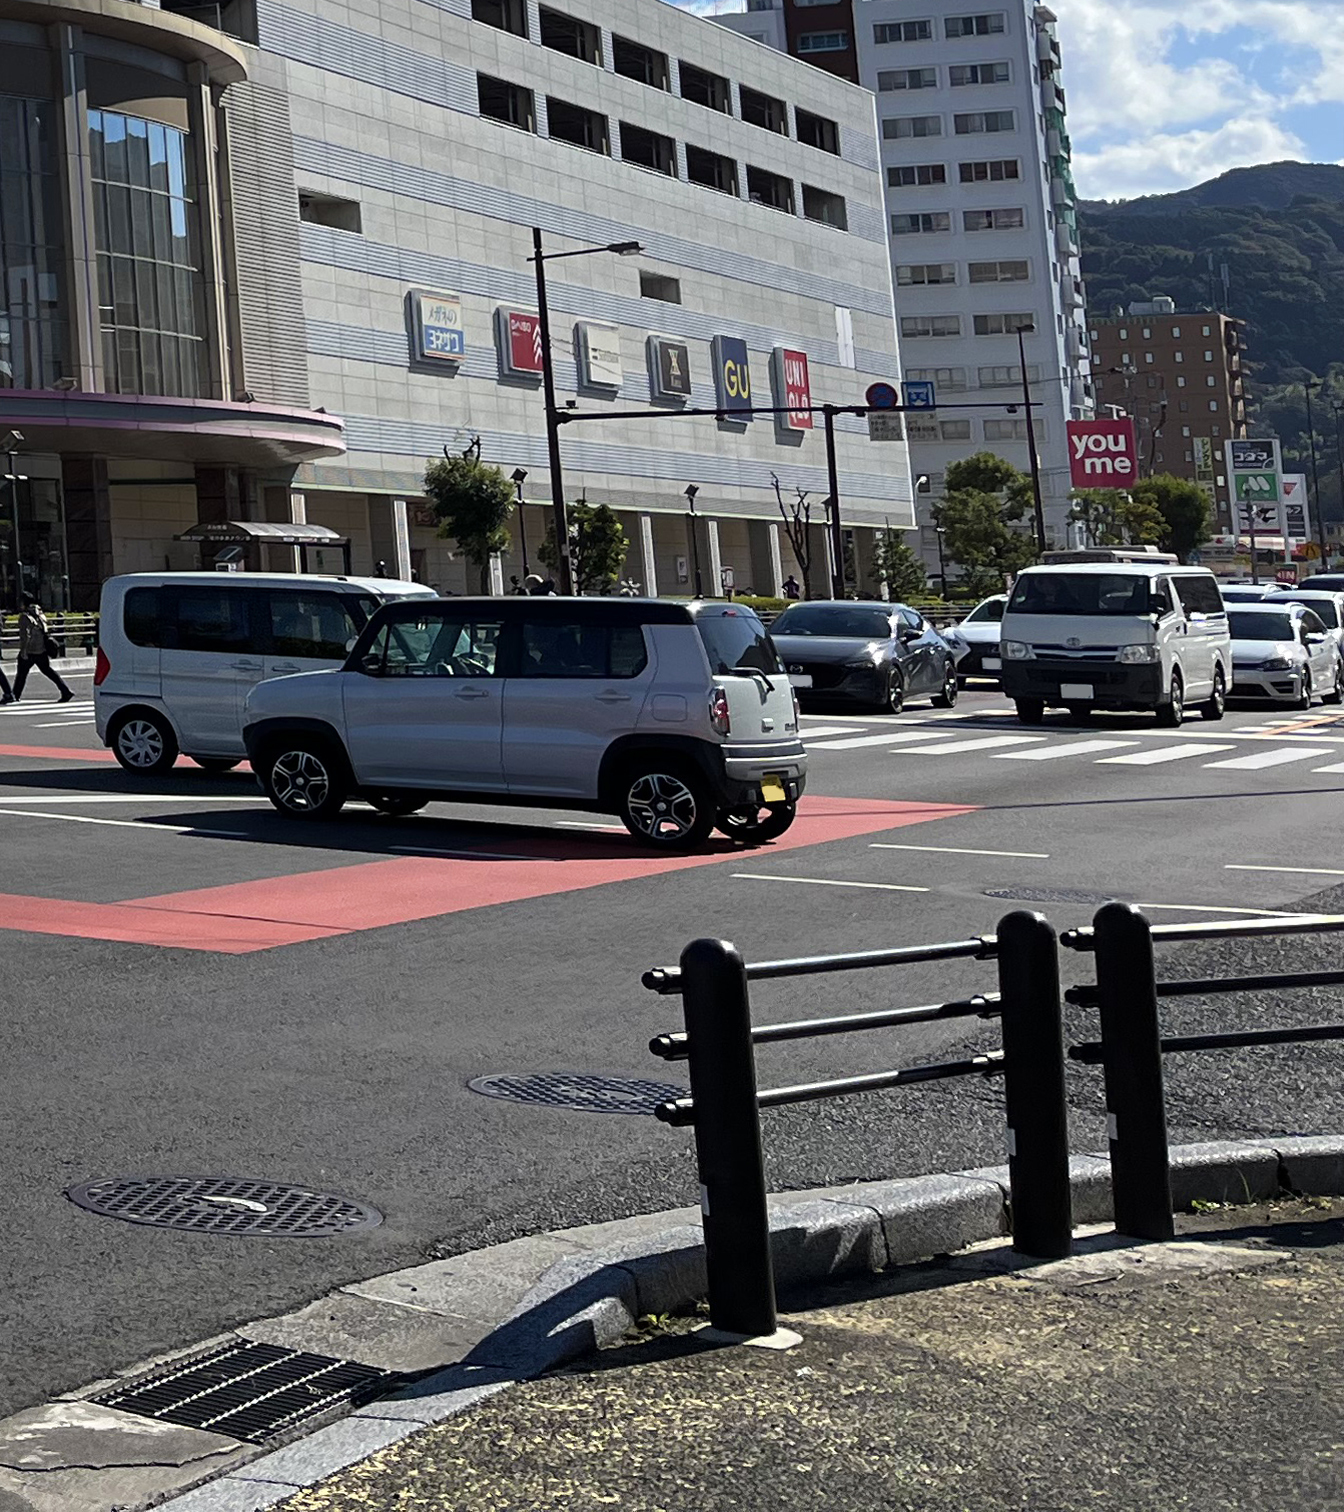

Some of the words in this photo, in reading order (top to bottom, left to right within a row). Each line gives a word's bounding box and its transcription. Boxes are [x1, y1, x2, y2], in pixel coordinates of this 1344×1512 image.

[724, 359, 749, 399] GU
[784, 358, 805, 388] UNI
[788, 391, 810, 424] QLO
[1071, 433, 1127, 460] you
[1084, 456, 1132, 474] me
